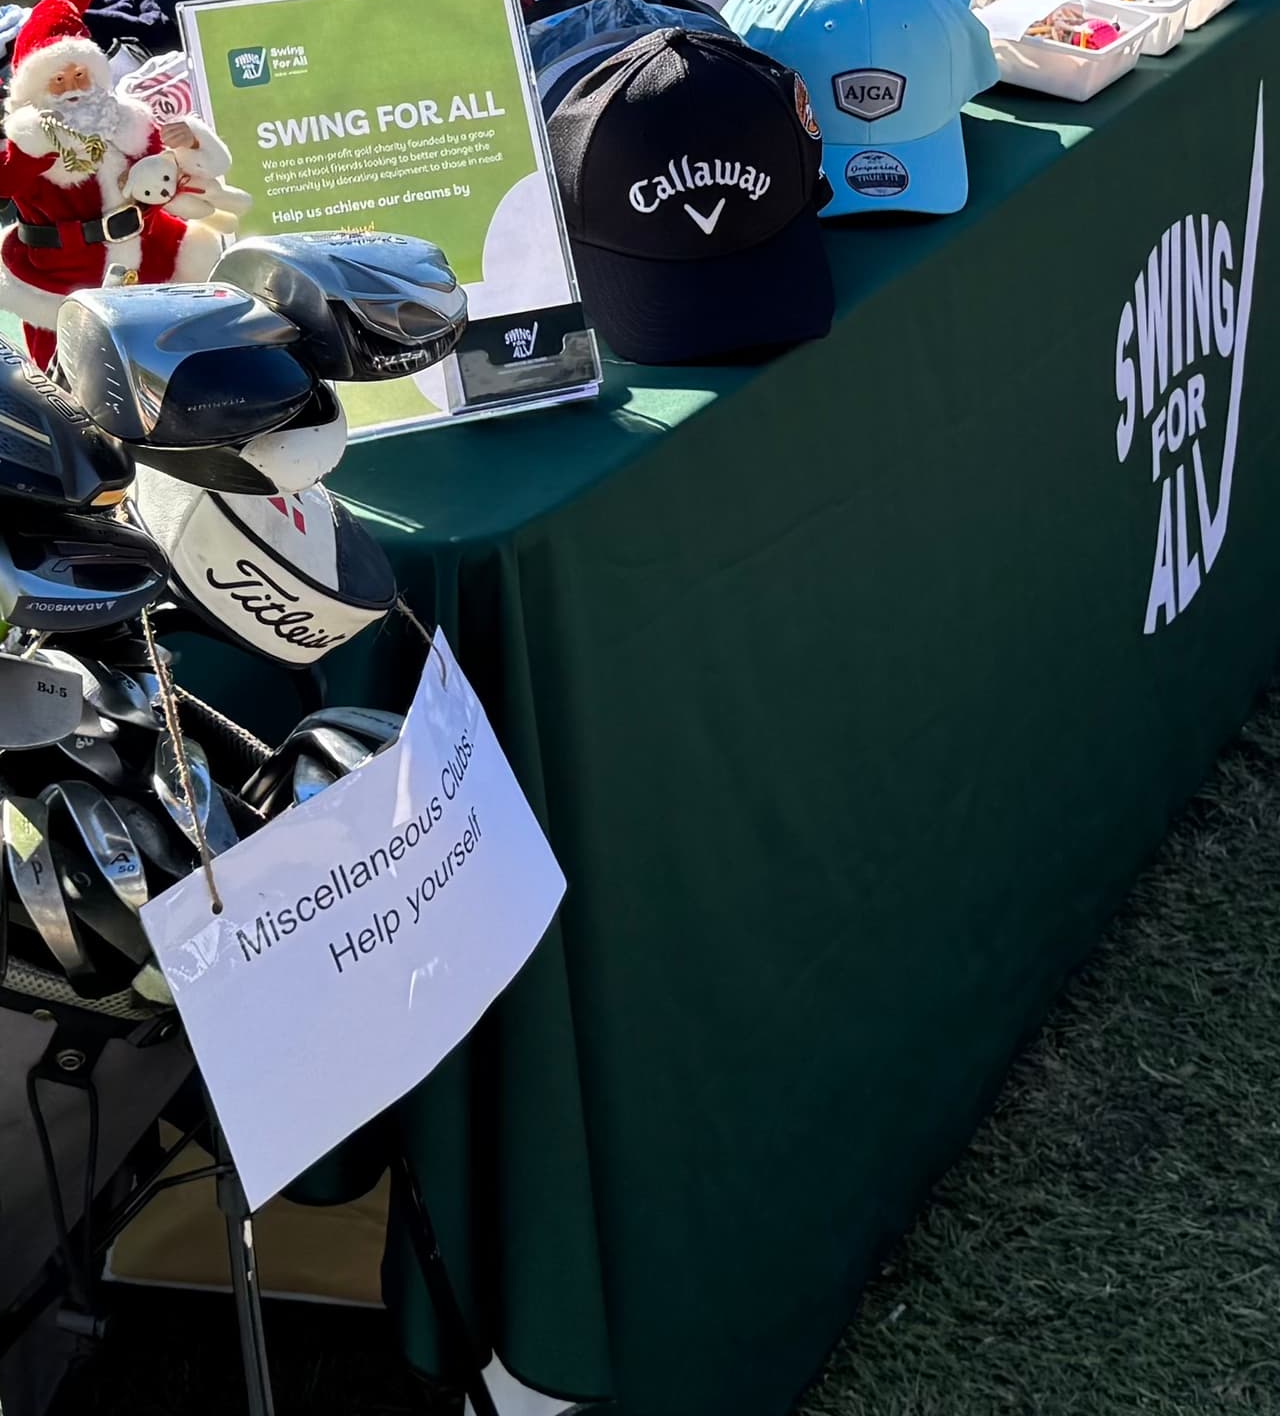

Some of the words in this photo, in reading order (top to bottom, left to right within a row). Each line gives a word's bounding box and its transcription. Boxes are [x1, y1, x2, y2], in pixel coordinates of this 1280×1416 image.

[269, 44, 305, 58] Swing
[292, 54, 308, 68] All
[844, 85, 895, 104] AJGA
[256, 108, 370, 149] SWING
[376, 99, 443, 133] FOR
[447, 90, 506, 123] ALL
[262, 159, 278, 170] We
[373, 141, 407, 154] charity
[407, 134, 446, 149] founded
[446, 133, 460, 144] by
[467, 128, 496, 142] group
[275, 170, 297, 183] high
[363, 155, 398, 169] looking
[398, 154, 409, 163] to
[410, 150, 439, 162] better
[440, 145, 474, 157] change
[474, 142, 490, 152] the
[266, 180, 321, 197] community
[336, 170, 379, 186] donating
[380, 164, 429, 180] equipment
[429, 163, 441, 172] to
[441, 159, 467, 170] those
[468, 156, 478, 166] in
[628, 154, 771, 214] Callaway
[272, 208, 305, 224] Help
[306, 208, 323, 219] us
[324, 198, 376, 217] achieve
[377, 193, 401, 208] our
[402, 186, 452, 203] dreams
[452, 183, 471, 197] by
[503, 327, 532, 346] SWING
[1116, 213, 1235, 463] SWING
[1151, 373, 1208, 484] FOR
[234, 799, 444, 963] Miscellaneous
[327, 907, 402, 973] Help
[410, 806, 485, 925] yourself
